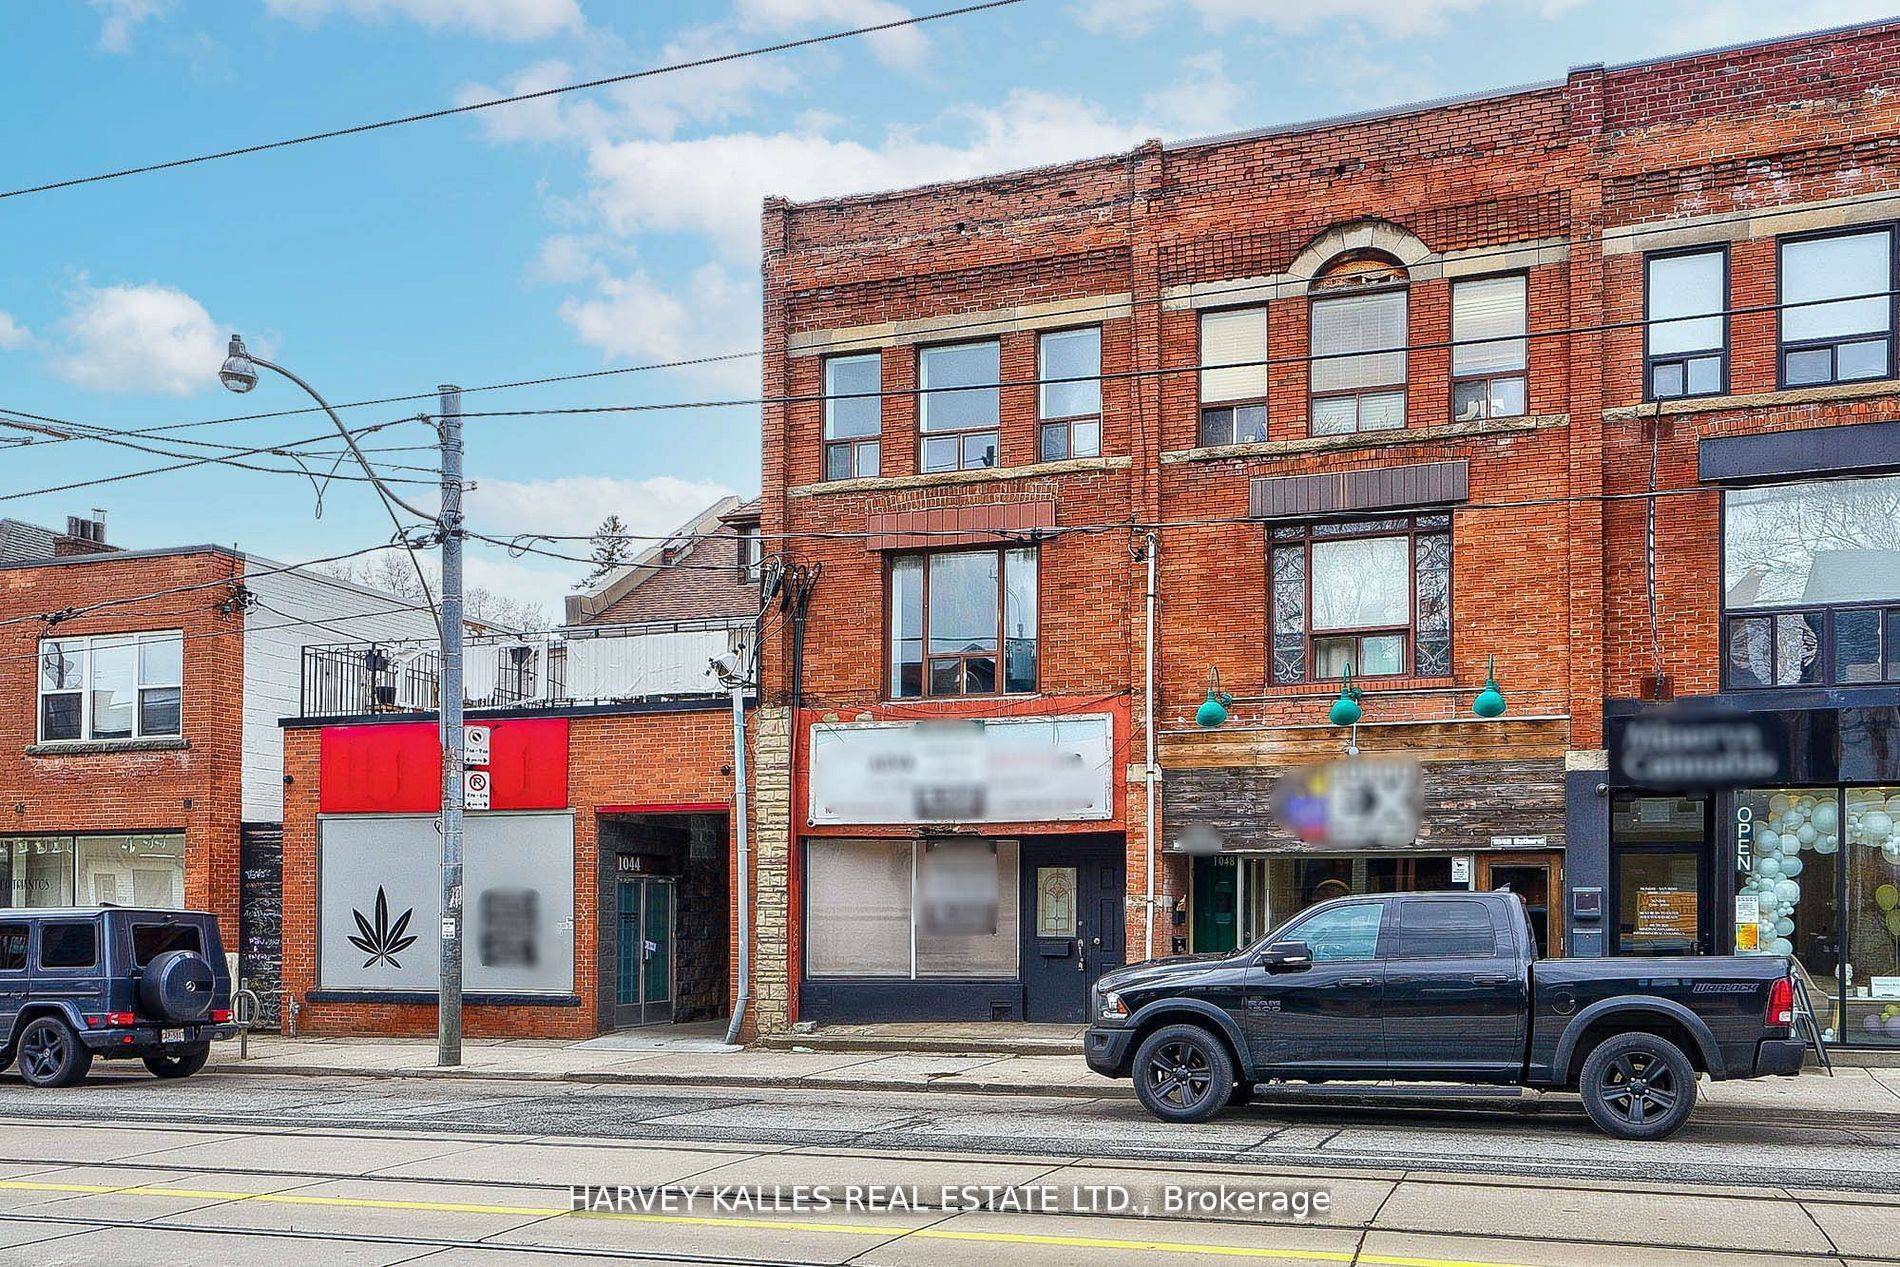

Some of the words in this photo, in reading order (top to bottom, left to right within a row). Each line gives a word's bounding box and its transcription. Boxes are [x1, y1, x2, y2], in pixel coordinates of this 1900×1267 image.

[1737, 806, 1752, 871] OPEN
[618, 856, 641, 871] 1044
[1213, 856, 1235, 867] 1048
[1693, 983, 1760, 993] WARLOCK
